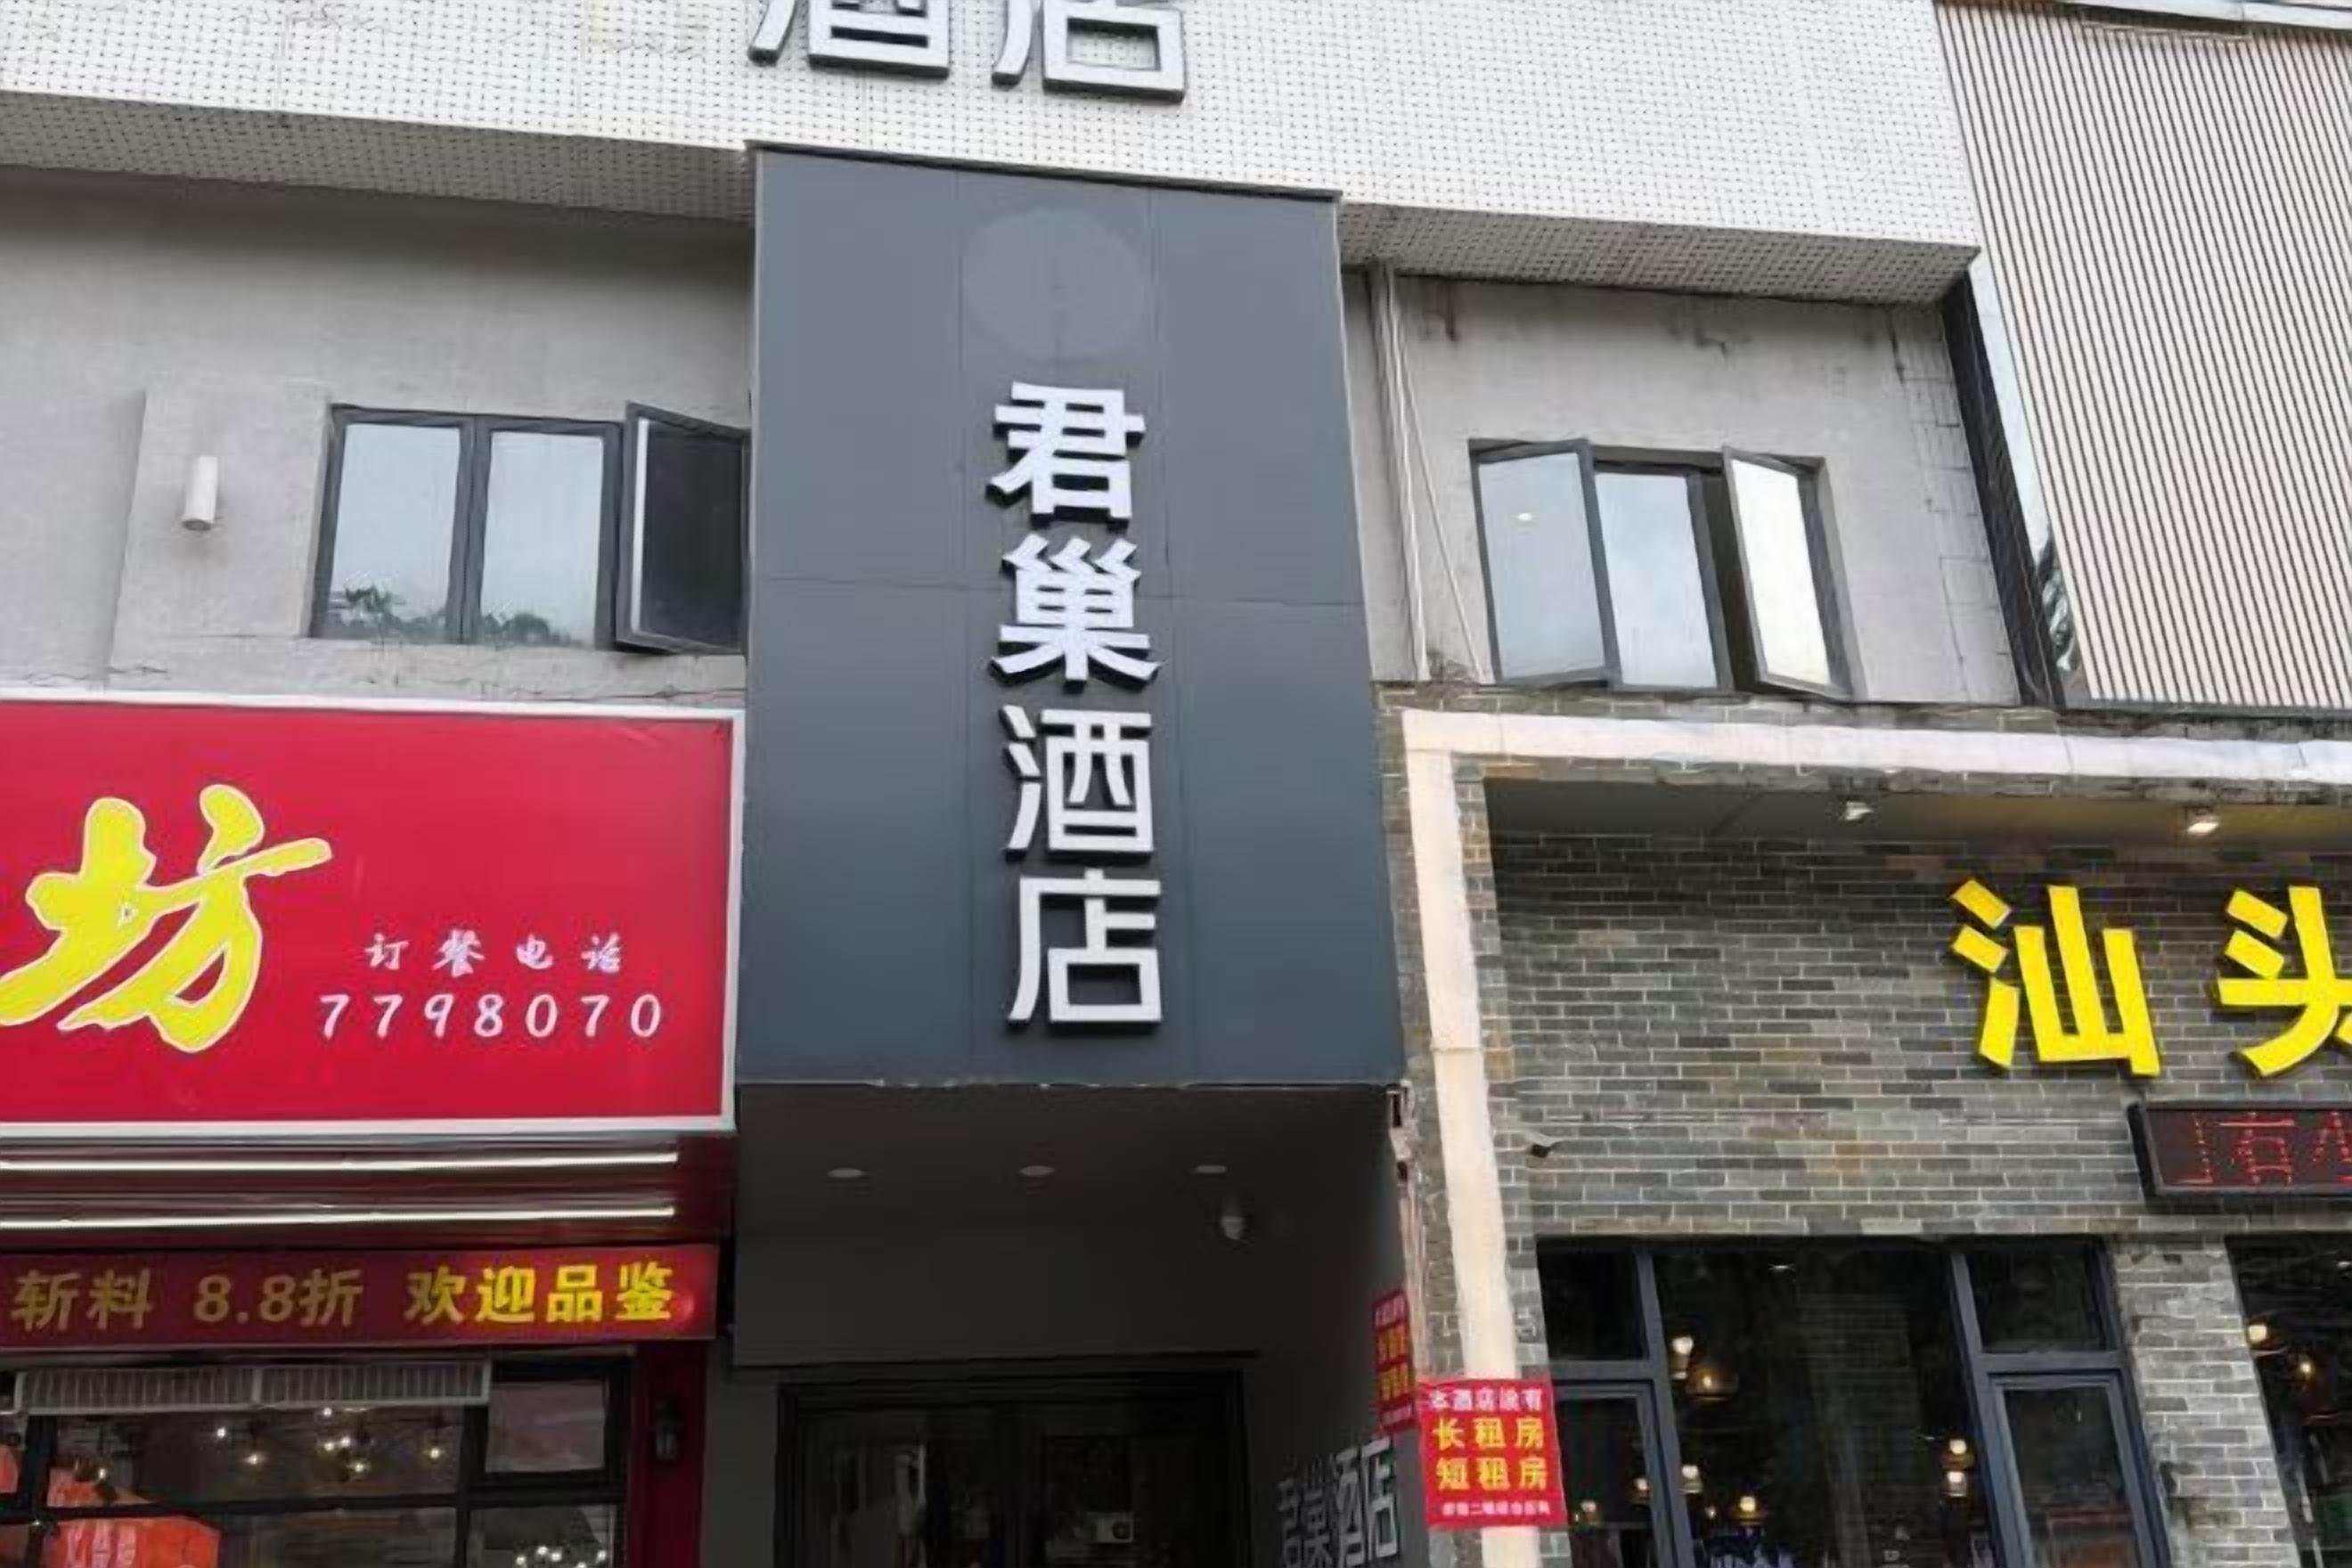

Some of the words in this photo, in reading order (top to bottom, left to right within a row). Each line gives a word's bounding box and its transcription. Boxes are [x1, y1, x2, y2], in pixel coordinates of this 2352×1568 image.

[986, 381, 1162, 1026] 君巢酒店
[0, 784, 332, 1053] 坊
[364, 928, 623, 977] 订餐电话
[1951, 878, 2352, 1077] 汕头
[318, 992, 662, 1039] 7798070
[193, 1269, 363, 1327] 8.8折
[404, 1260, 674, 1325] 欢迎品鉴
[1433, 1416, 1545, 1450] 长租房
